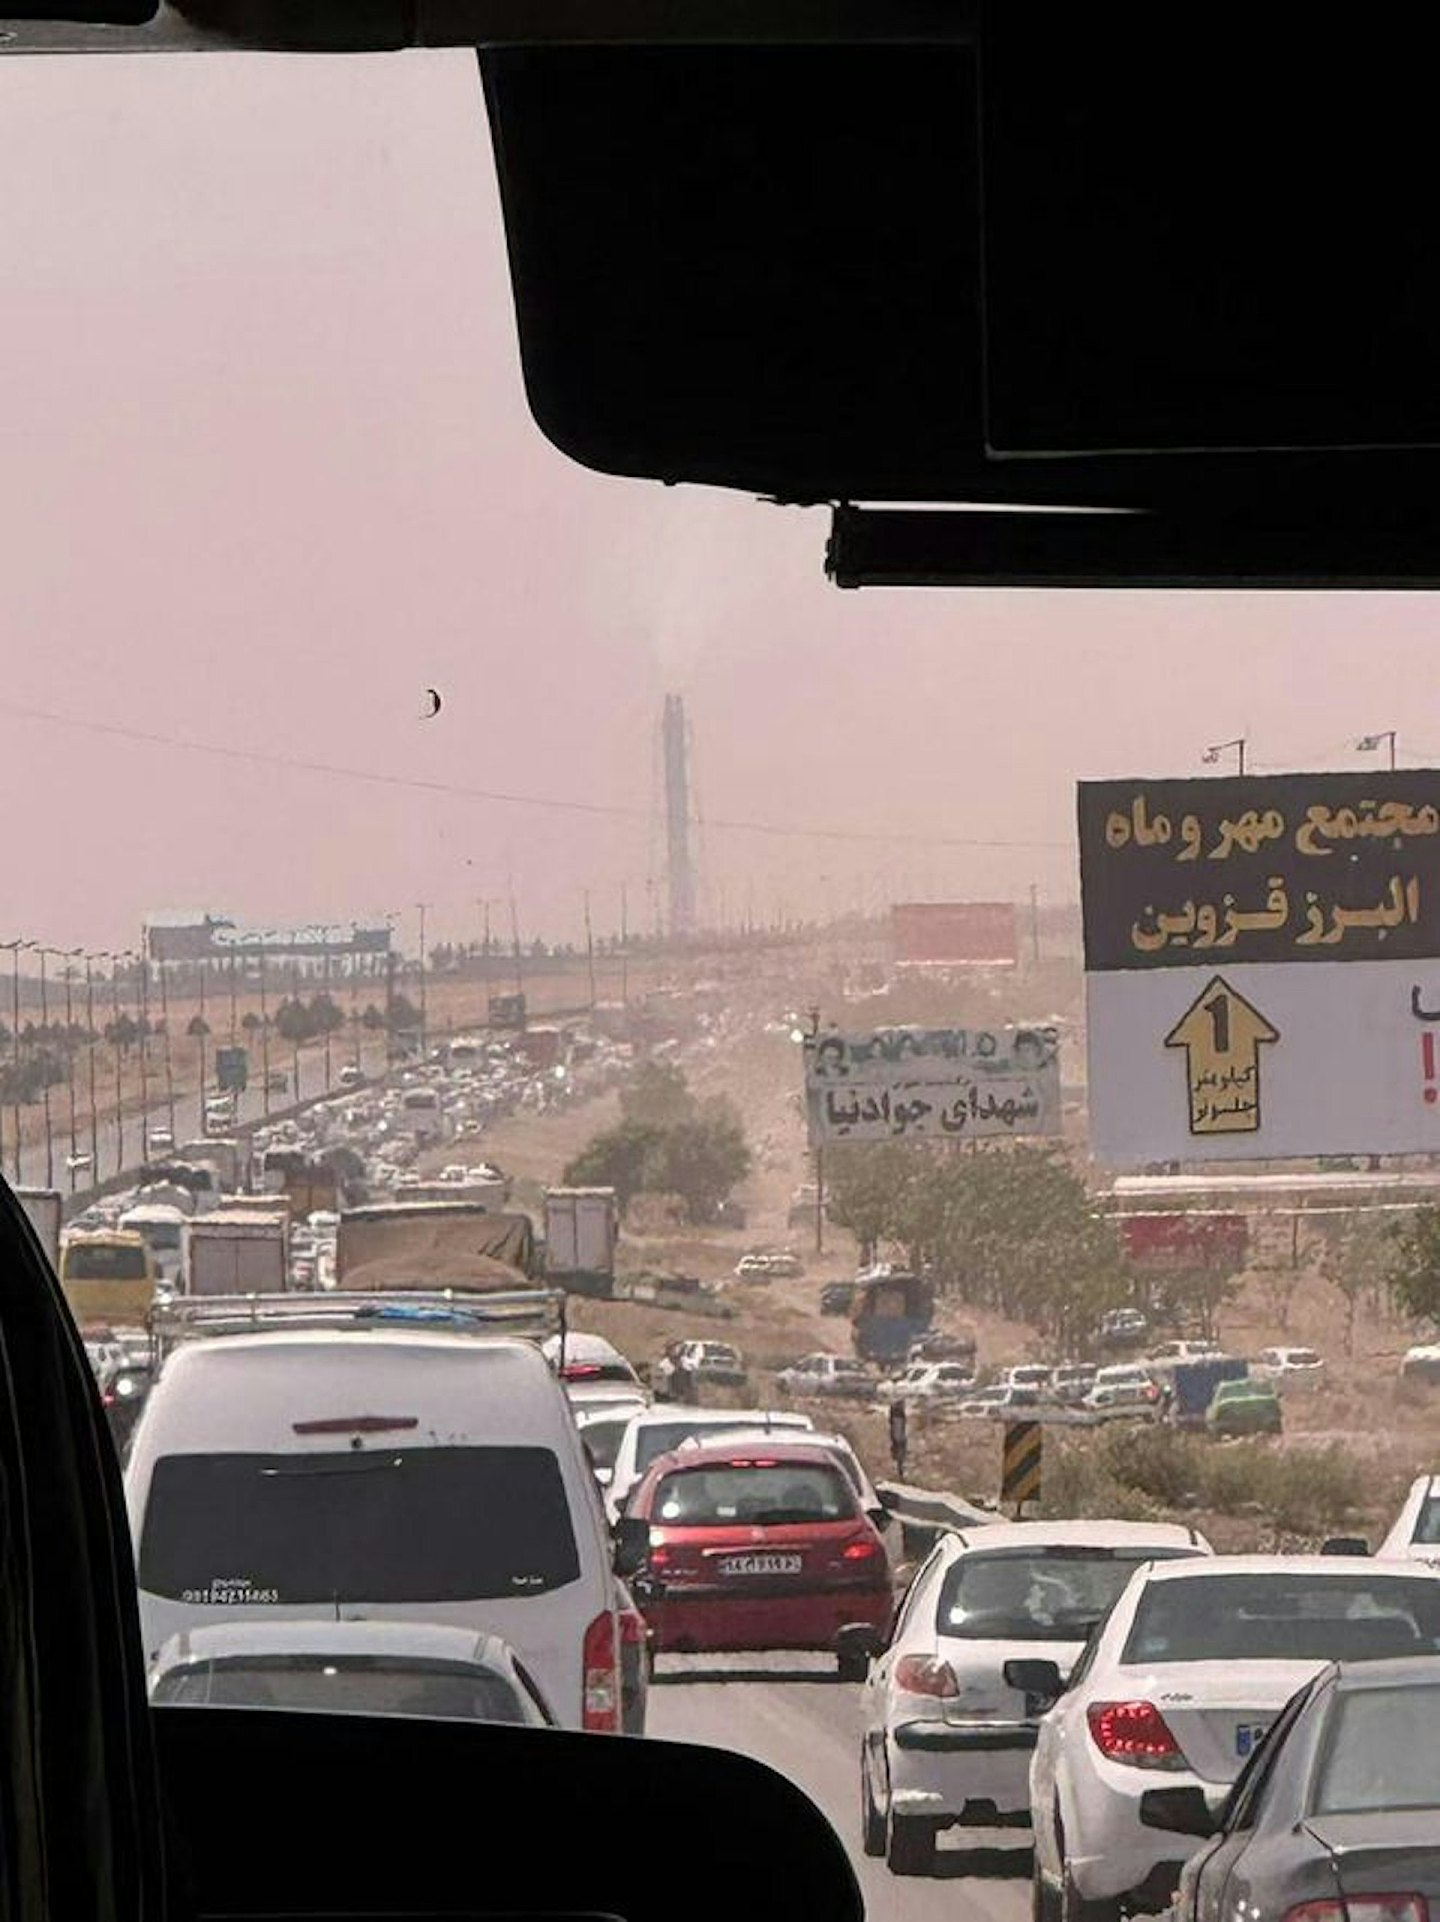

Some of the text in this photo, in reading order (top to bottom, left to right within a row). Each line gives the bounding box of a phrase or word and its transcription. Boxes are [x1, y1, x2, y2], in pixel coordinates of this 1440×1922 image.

[1295, 799, 1440, 856] مجتمع
[1131, 874, 1421, 951] البرز قزوین
[941, 1084, 1040, 1133] شهدای
